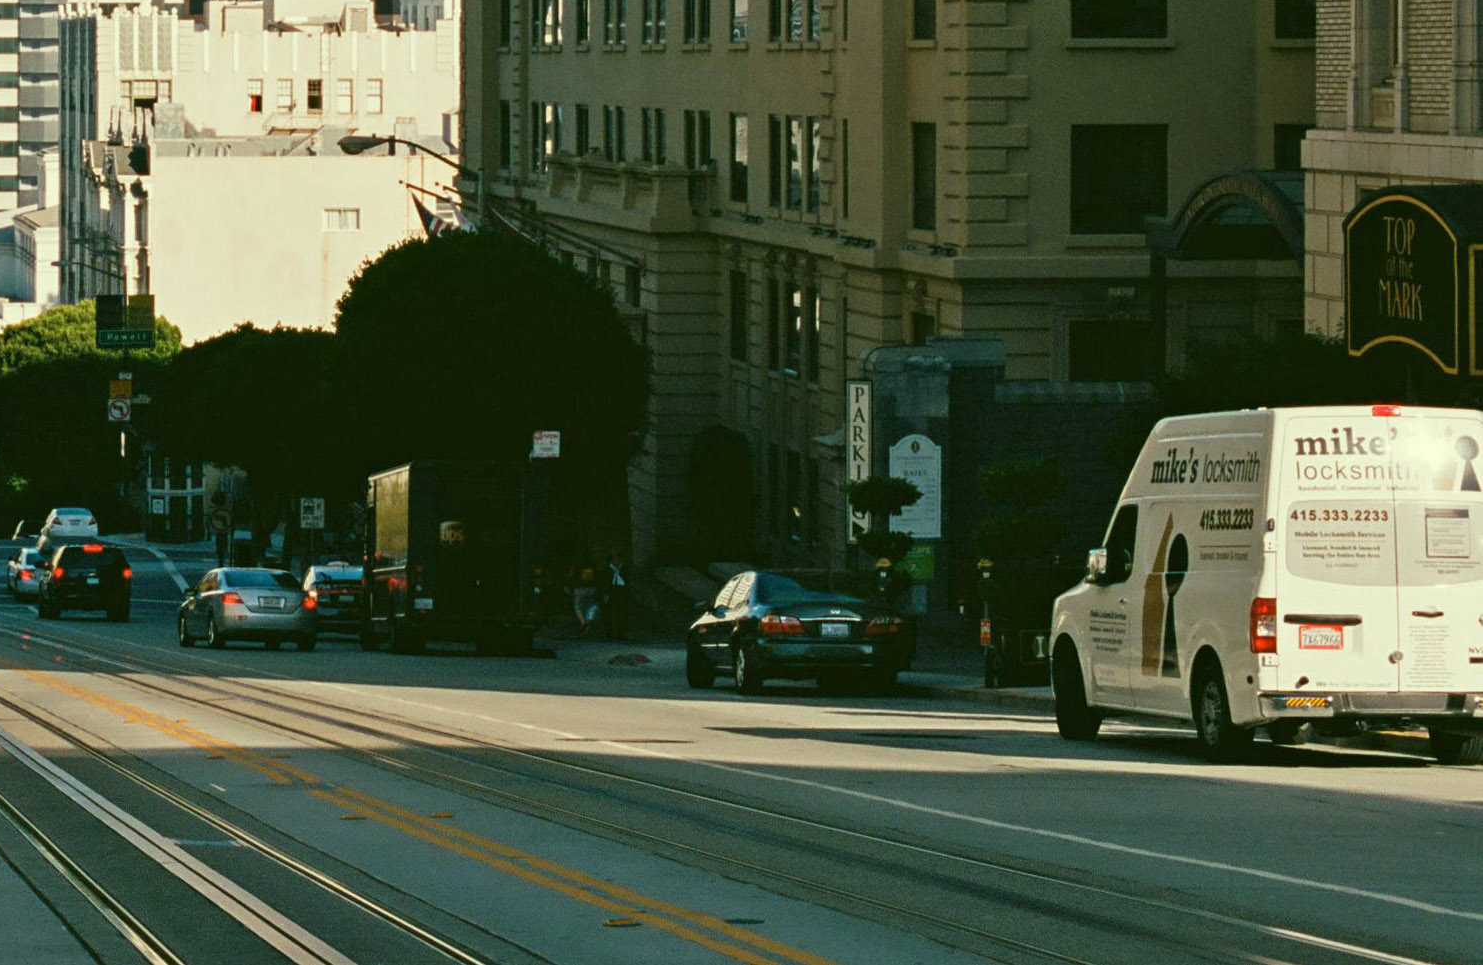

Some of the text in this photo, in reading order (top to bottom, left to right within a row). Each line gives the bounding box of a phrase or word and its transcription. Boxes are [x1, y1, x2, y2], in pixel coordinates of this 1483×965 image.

[1383, 216, 1416, 256] TOP
[1379, 278, 1423, 321] MARK
[107, 331, 147, 341] Powell
[1150, 447, 1261, 484] mike's locksmith
[1199, 508, 1255, 532] 415.333.2233
[1290, 509, 1389, 522] 415.333.2233
